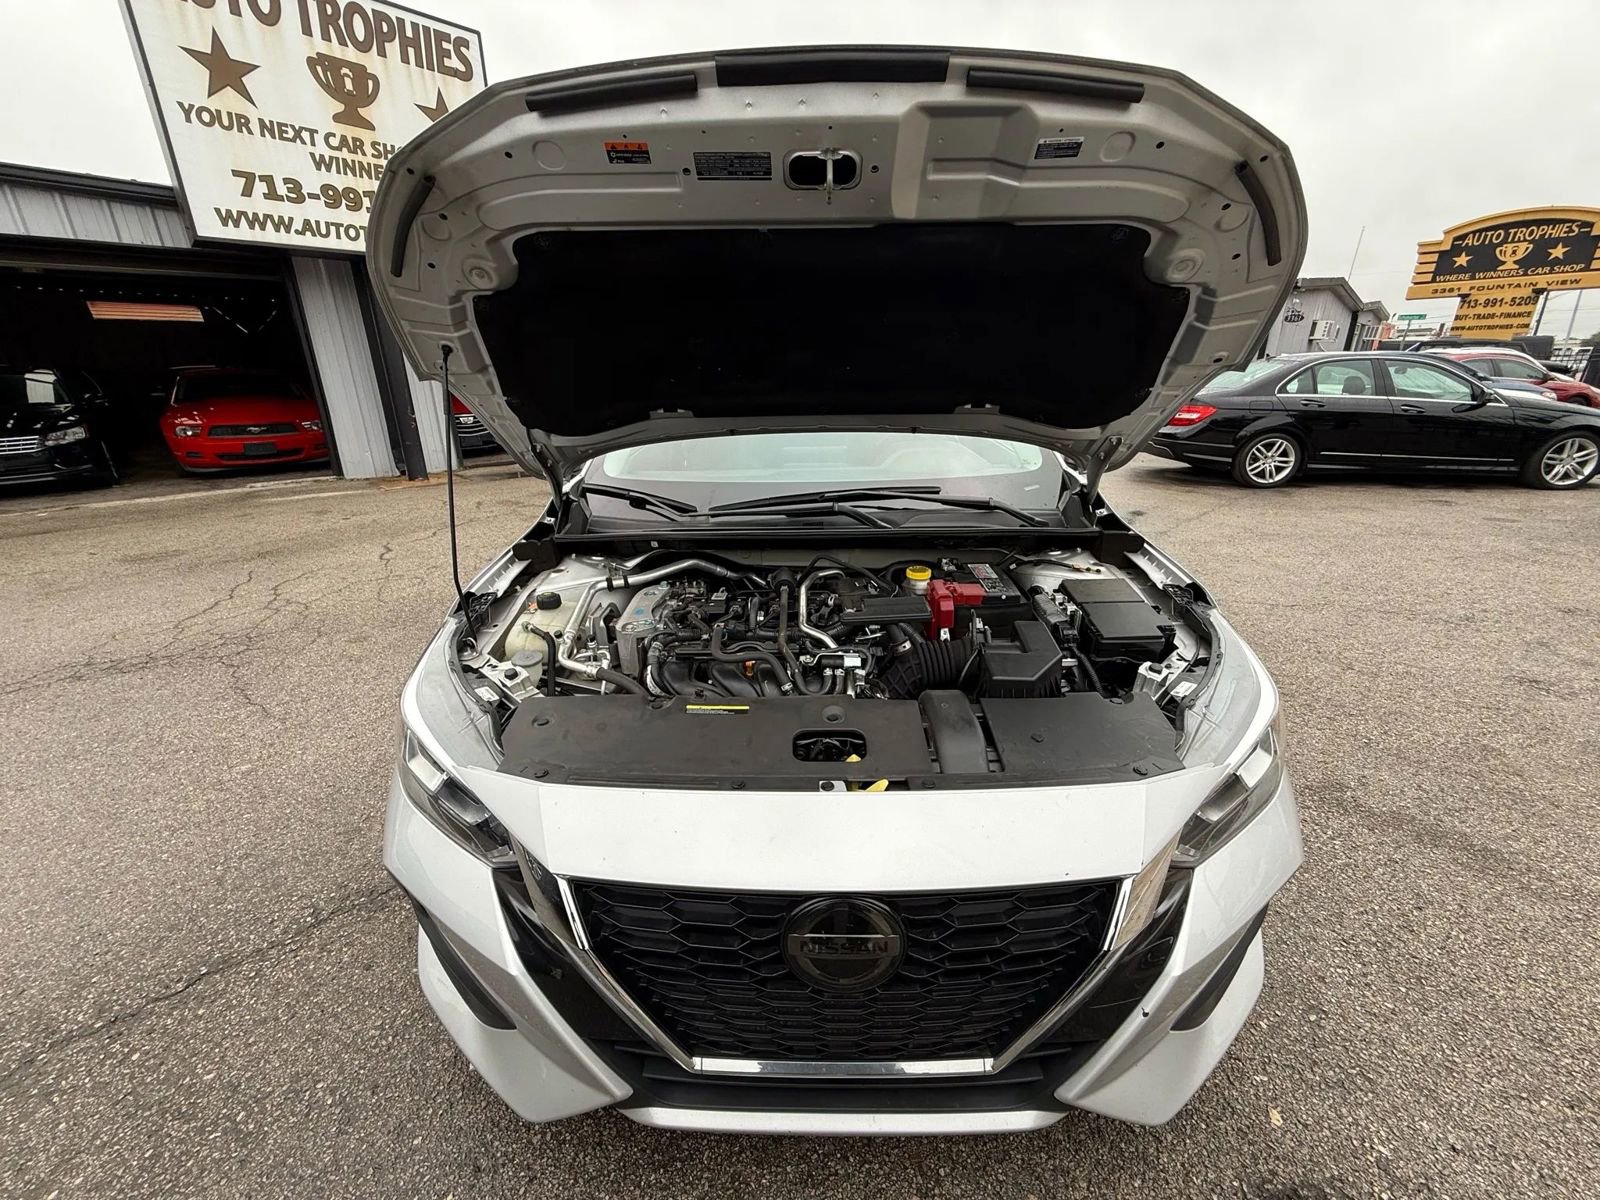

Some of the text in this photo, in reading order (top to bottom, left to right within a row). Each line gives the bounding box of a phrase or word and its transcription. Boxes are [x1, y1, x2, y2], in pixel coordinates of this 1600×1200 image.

[297, 0, 474, 82] TROPHIES
[176, 100, 402, 160] YOUR NEXT CAR SH
[1435, 263, 1585, 282] WHERE WINNERS CAR SHOP
[1468, 281, 1539, 293] FOUNTAIN
[1545, 278, 1583, 287] VIEW
[1460, 295, 1540, 310] 713-991-5209
[800, 940, 889, 954] NISSAN
